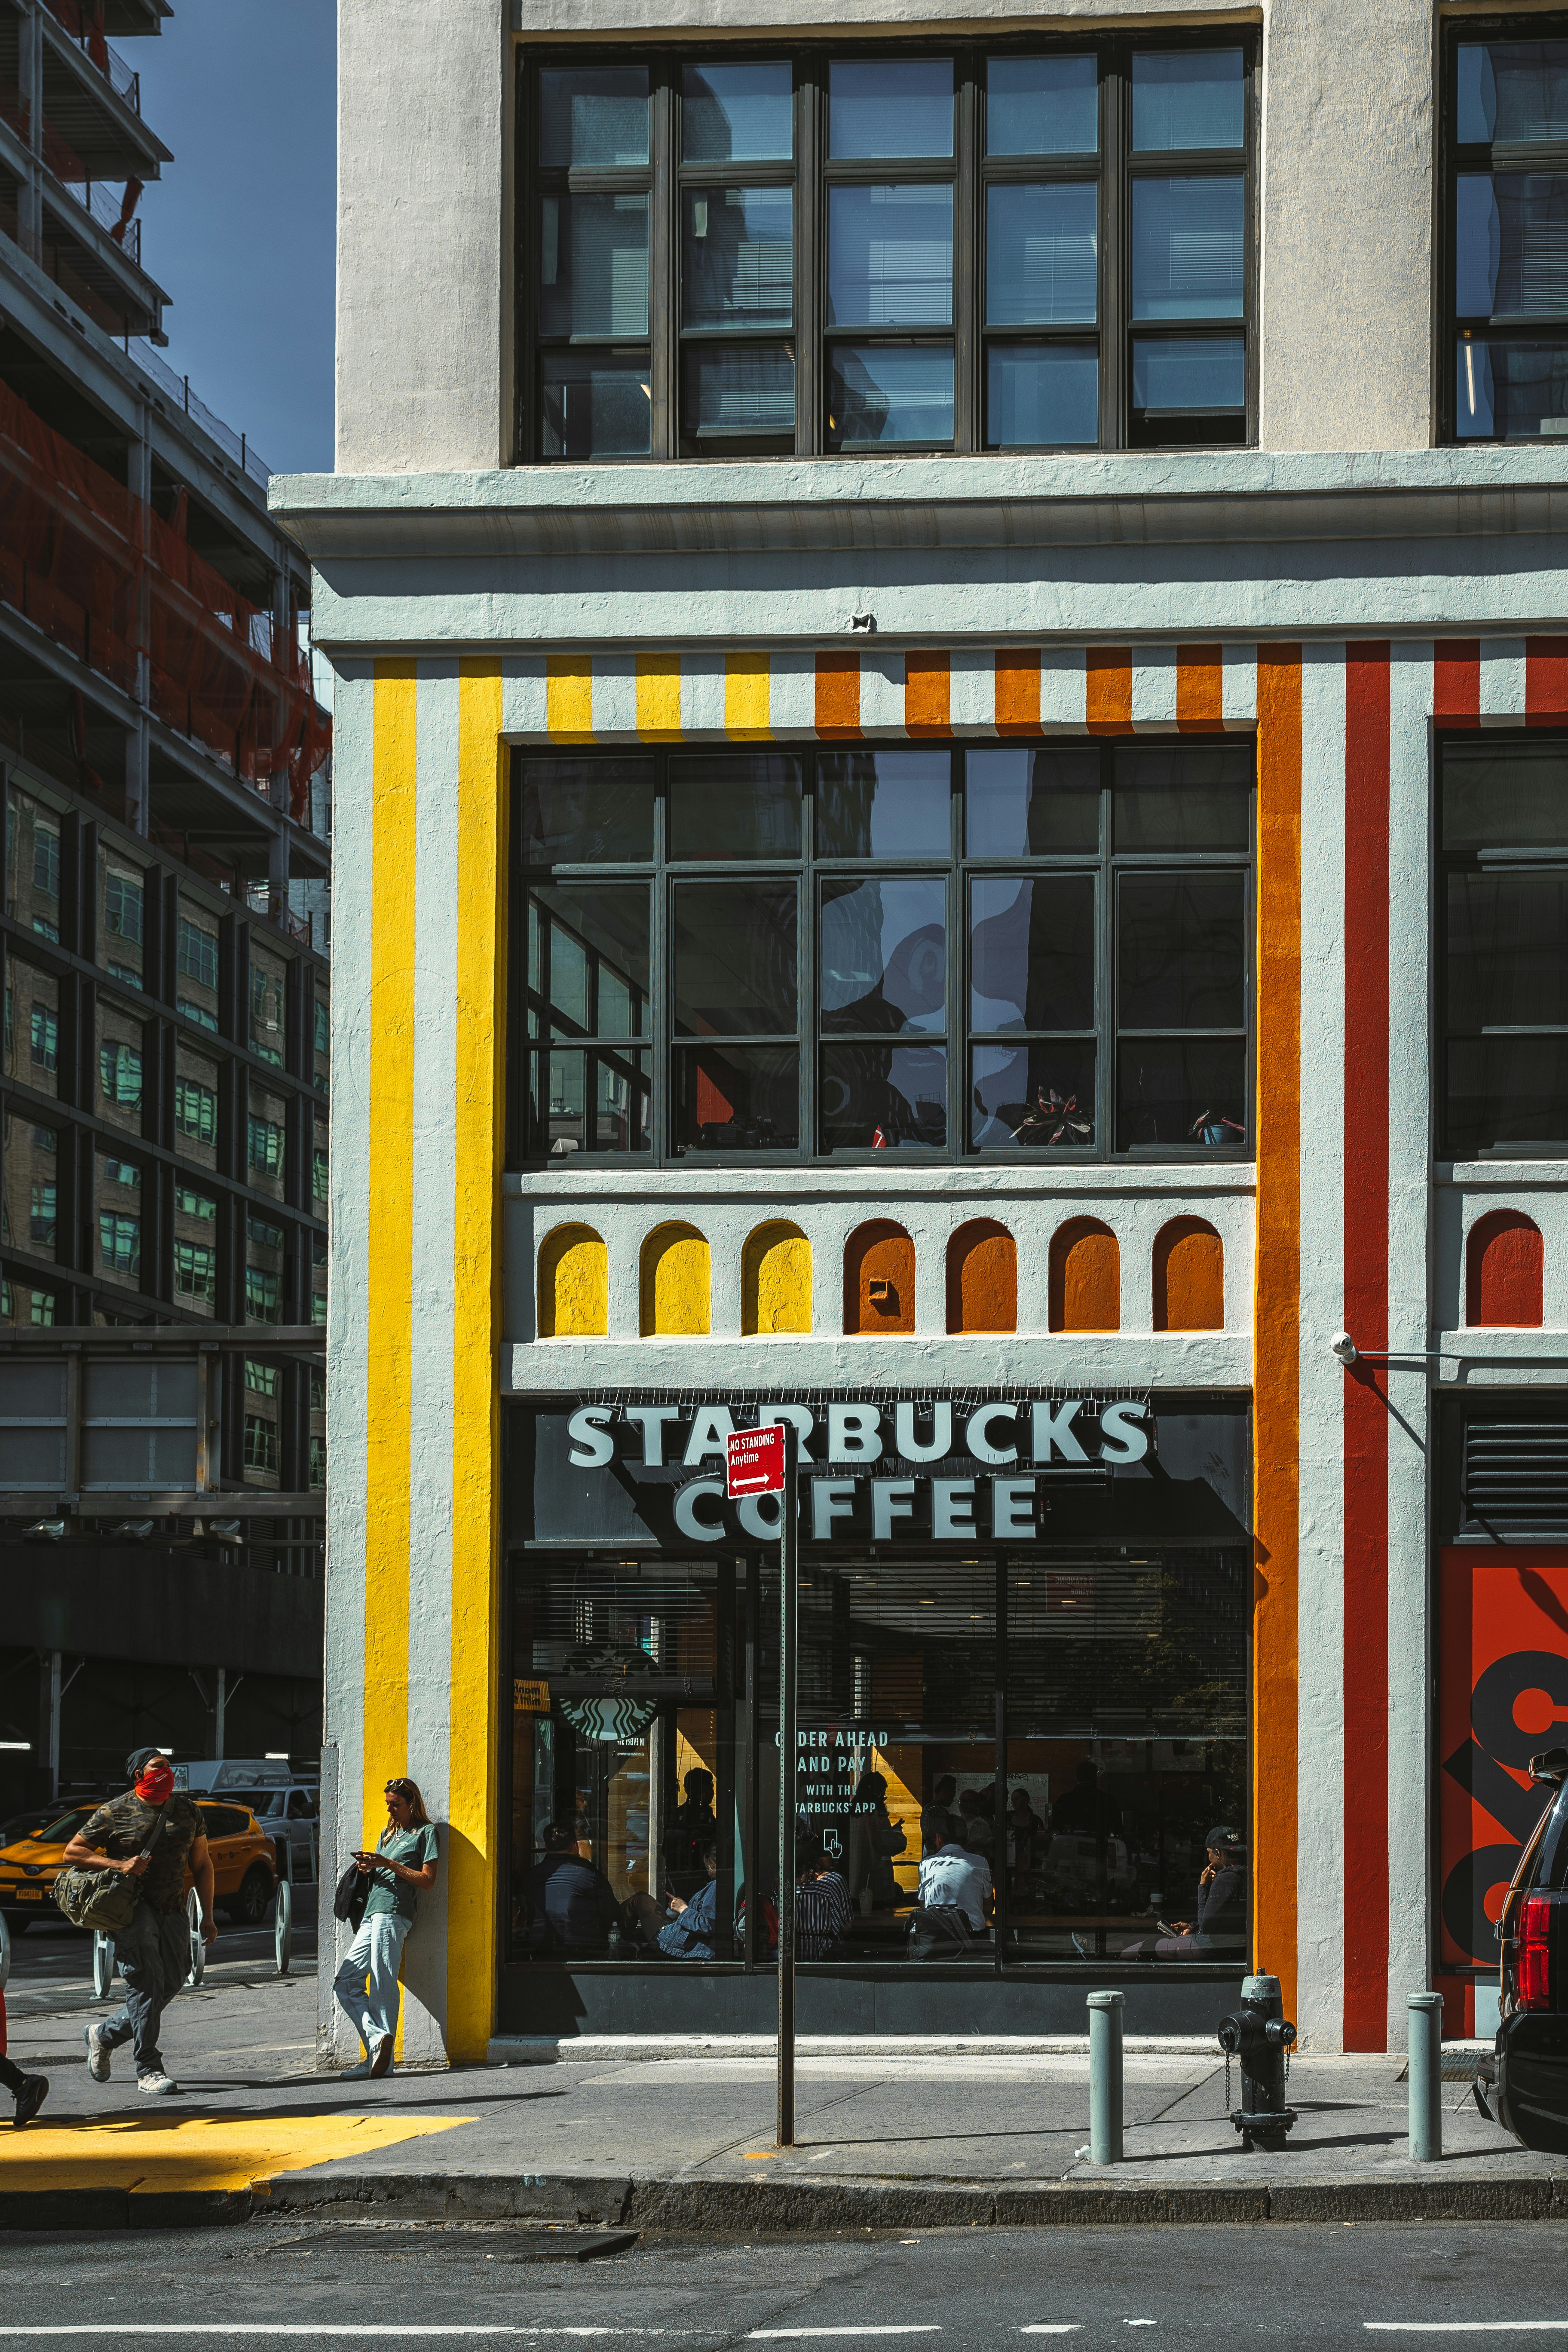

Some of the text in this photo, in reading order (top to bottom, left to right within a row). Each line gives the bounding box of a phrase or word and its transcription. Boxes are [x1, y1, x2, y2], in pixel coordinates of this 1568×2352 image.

[730, 1433, 775, 1452] NO STANDING
[731, 1452, 759, 1467] Anytime
[775, 1731, 888, 1747] ODER AHEAD
[797, 1757, 865, 1772] AND PAY
[806, 1785, 857, 1795] WITH THE
[855, 1803, 876, 1813] APP
